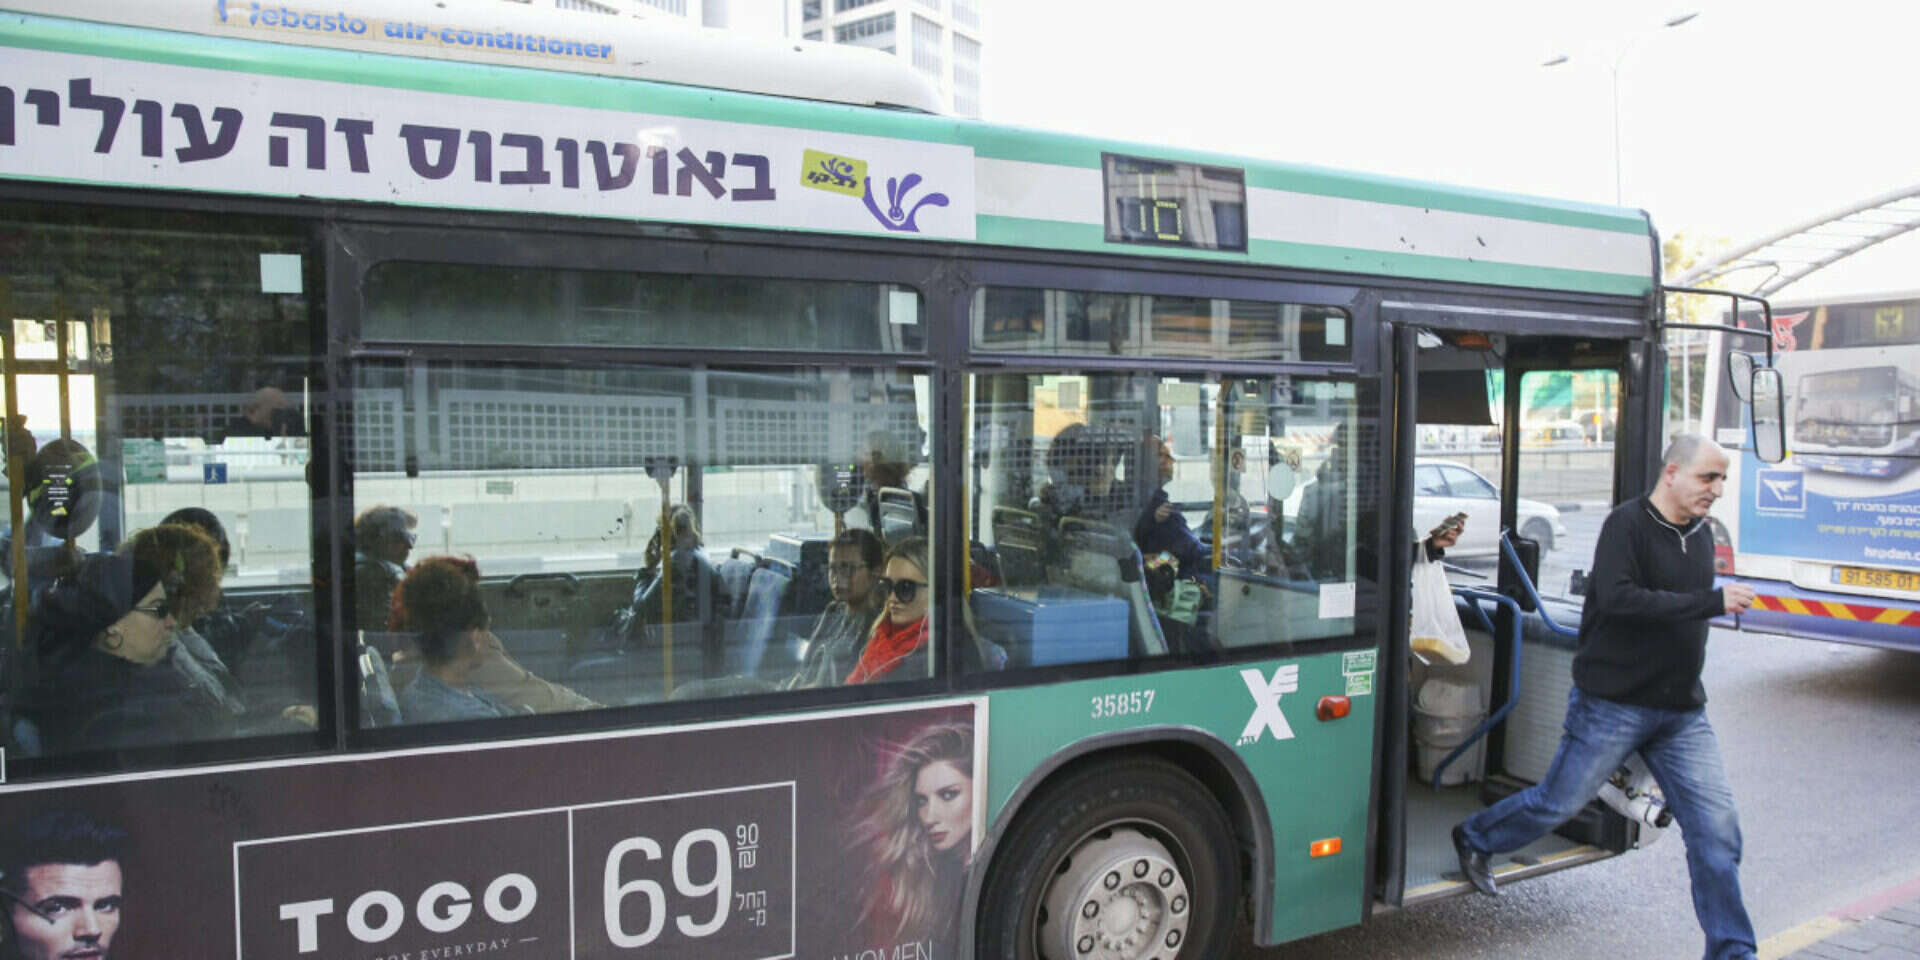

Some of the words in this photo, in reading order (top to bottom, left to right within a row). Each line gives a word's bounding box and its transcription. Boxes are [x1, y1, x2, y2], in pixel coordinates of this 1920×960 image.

[384, 21, 613, 59] air-conditioner
[269, 112, 375, 174] זה
[399, 124, 777, 201] באוטובוס
[1091, 690, 1155, 719] 35857
[736, 823, 759, 846] 90
[603, 828, 732, 948] 69
[736, 890, 766, 911] החל
[280, 873, 538, 953] TOGO
[420, 938, 511, 960] EVERYDAY
[833, 939, 932, 960] MEN
